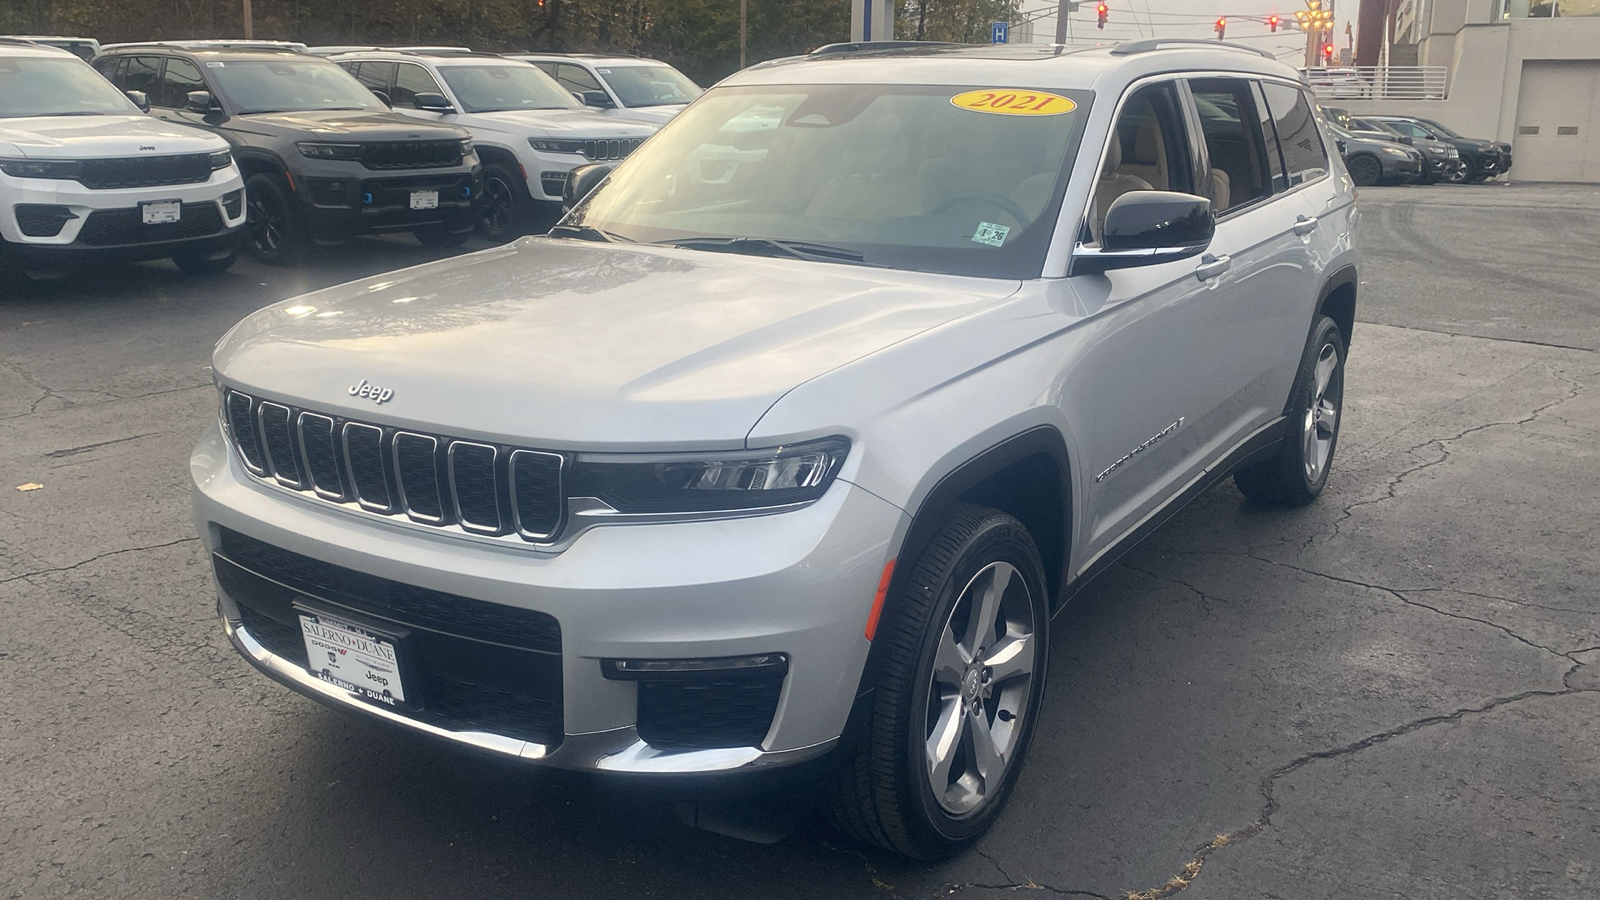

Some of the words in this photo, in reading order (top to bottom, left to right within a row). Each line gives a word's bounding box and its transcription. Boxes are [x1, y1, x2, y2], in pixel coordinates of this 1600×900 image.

[995, 28, 1004, 41] H
[967, 93, 1055, 111] 2021
[991, 231, 1005, 241] 26
[348, 379, 395, 405] Jeep
[303, 622, 352, 646] SALERNO
[356, 638, 394, 661] DUANE
[365, 670, 388, 686] Jeep
[318, 673, 354, 691] SALERNO
[367, 690, 395, 706] DUANE
